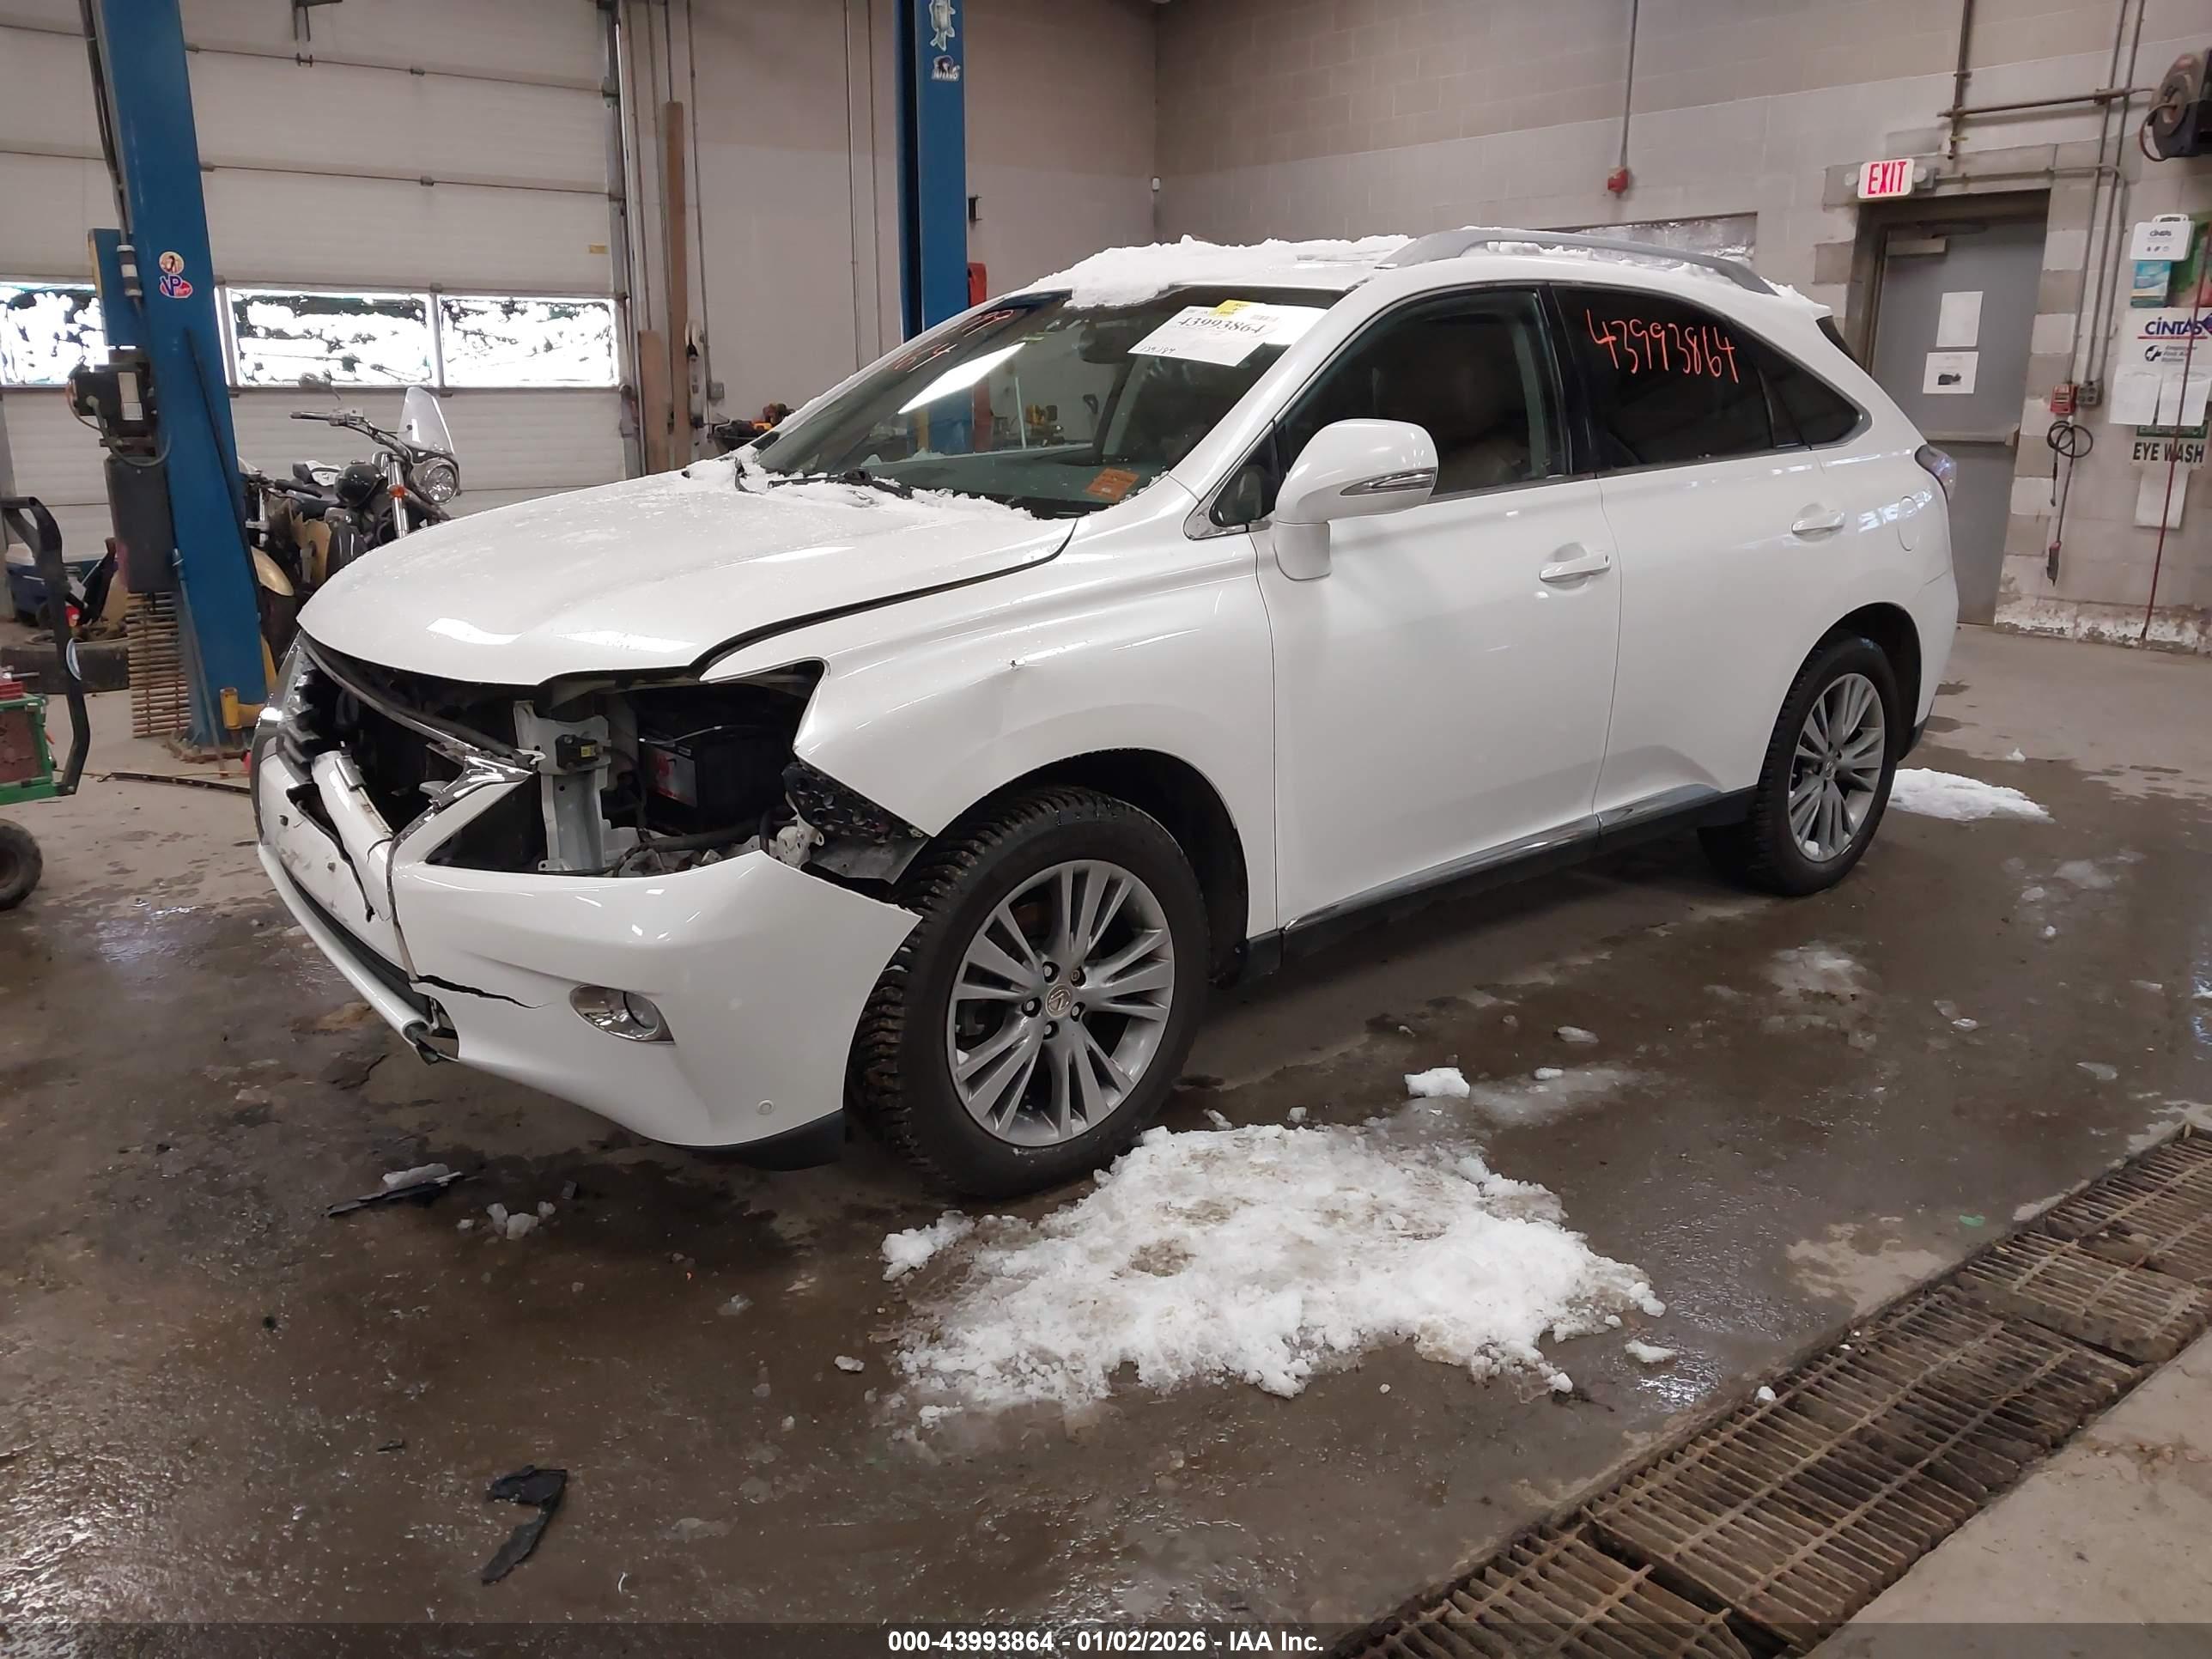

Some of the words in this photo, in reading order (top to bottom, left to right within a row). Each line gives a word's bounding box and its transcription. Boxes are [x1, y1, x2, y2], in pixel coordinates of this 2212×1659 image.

[1868, 161, 1906, 194] EXIT
[1177, 316, 1267, 334] 43993864
[1586, 308, 1740, 385] 43993864
[2132, 441, 2160, 461] EYE
[2164, 443, 2205, 464] WASH
